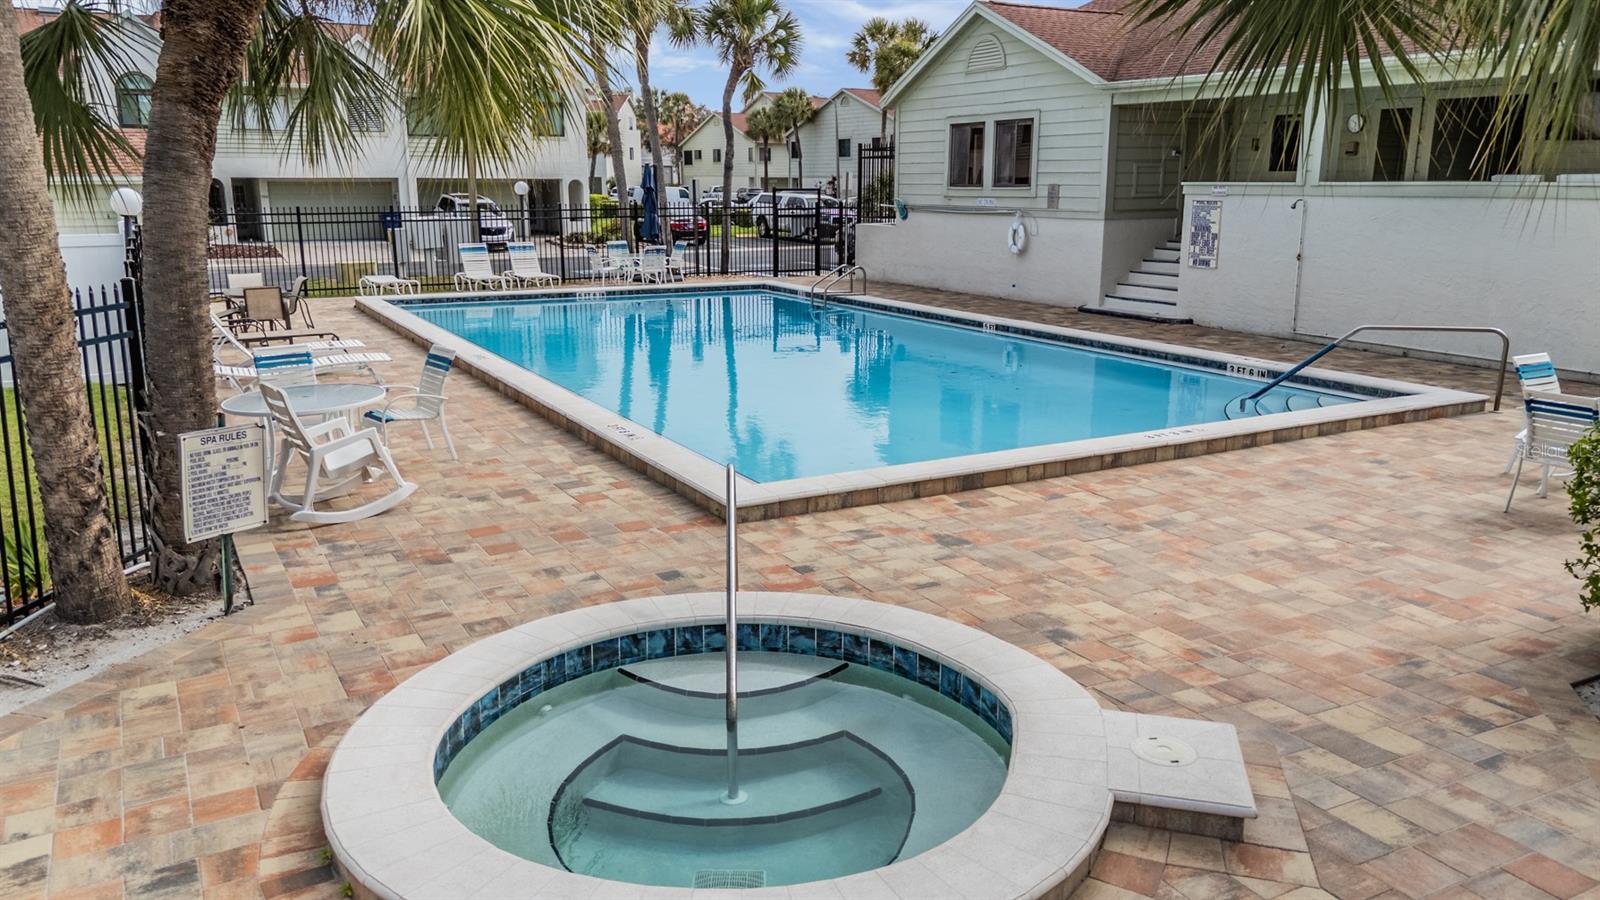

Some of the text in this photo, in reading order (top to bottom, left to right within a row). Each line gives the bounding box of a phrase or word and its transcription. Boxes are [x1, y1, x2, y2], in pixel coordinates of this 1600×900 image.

[1236, 366, 1246, 374] FT
[1258, 370, 1266, 378] IN
[200, 430, 247, 446] SPA RULES
